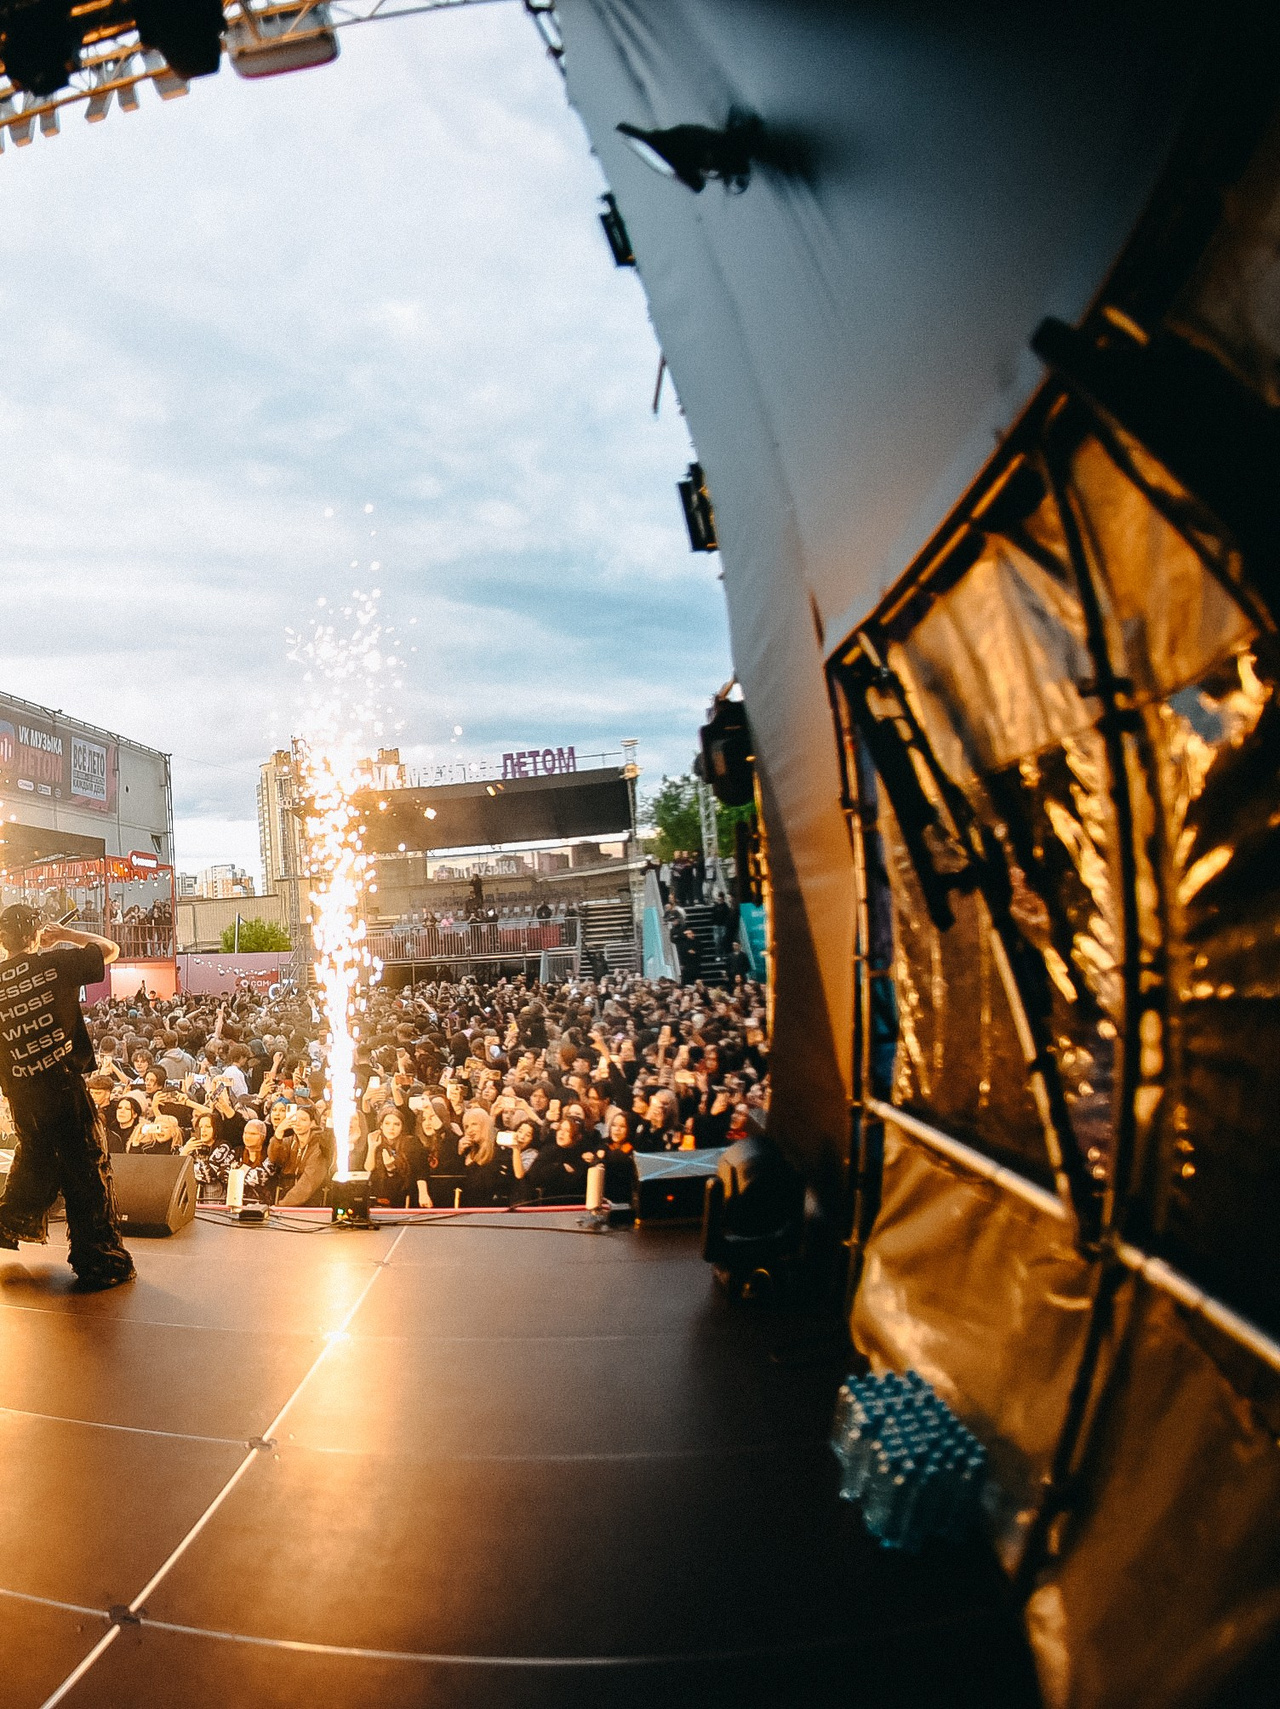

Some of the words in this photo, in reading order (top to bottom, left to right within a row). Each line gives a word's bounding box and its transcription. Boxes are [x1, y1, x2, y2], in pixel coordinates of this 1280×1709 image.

[30, 729, 63, 756] МУЗЫКА
[502, 746, 577, 780] ЛЕТОМ
[2, 1013, 54, 1042] WHO
[9, 1028, 66, 1061] LESS
